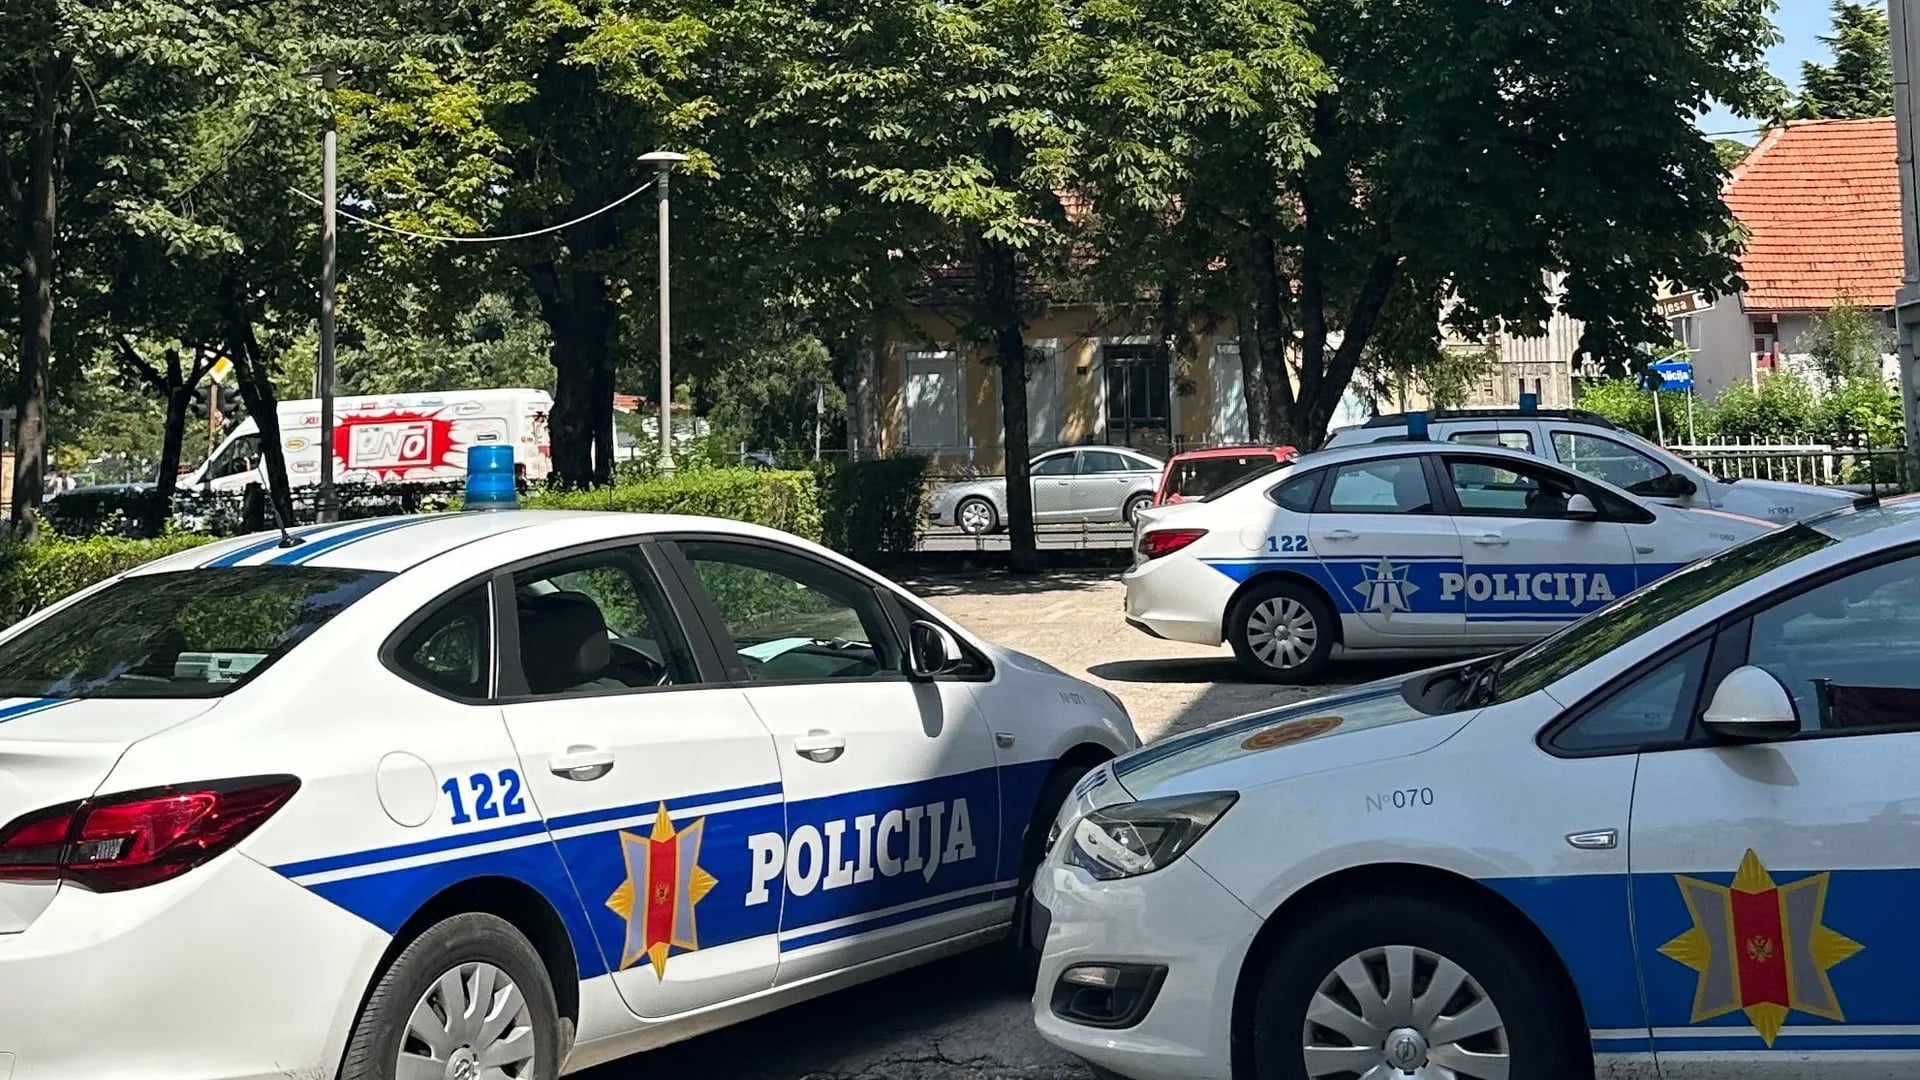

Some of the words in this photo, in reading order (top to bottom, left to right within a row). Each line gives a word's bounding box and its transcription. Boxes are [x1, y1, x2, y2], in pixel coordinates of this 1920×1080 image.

[1267, 535, 1308, 552] 122
[1439, 572, 1616, 607] POLICIJA
[441, 768, 526, 825] 122
[745, 798, 976, 906] POLICIJA
